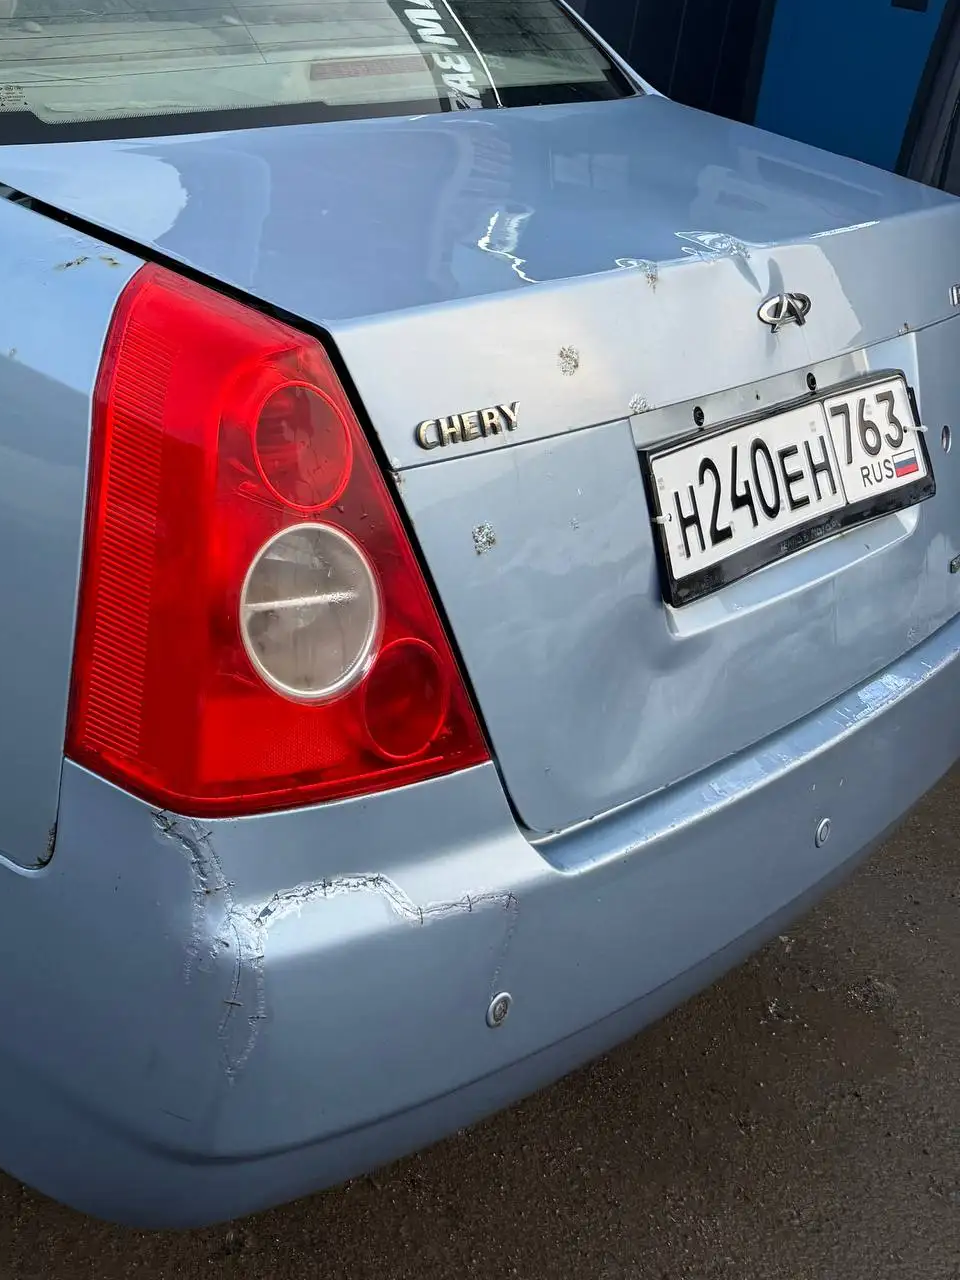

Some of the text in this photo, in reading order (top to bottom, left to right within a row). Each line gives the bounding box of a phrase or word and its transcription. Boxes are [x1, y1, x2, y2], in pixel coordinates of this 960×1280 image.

[413, 401, 521, 450] CHERY
[830, 389, 904, 465] 763
[860, 458, 895, 488] RUS
